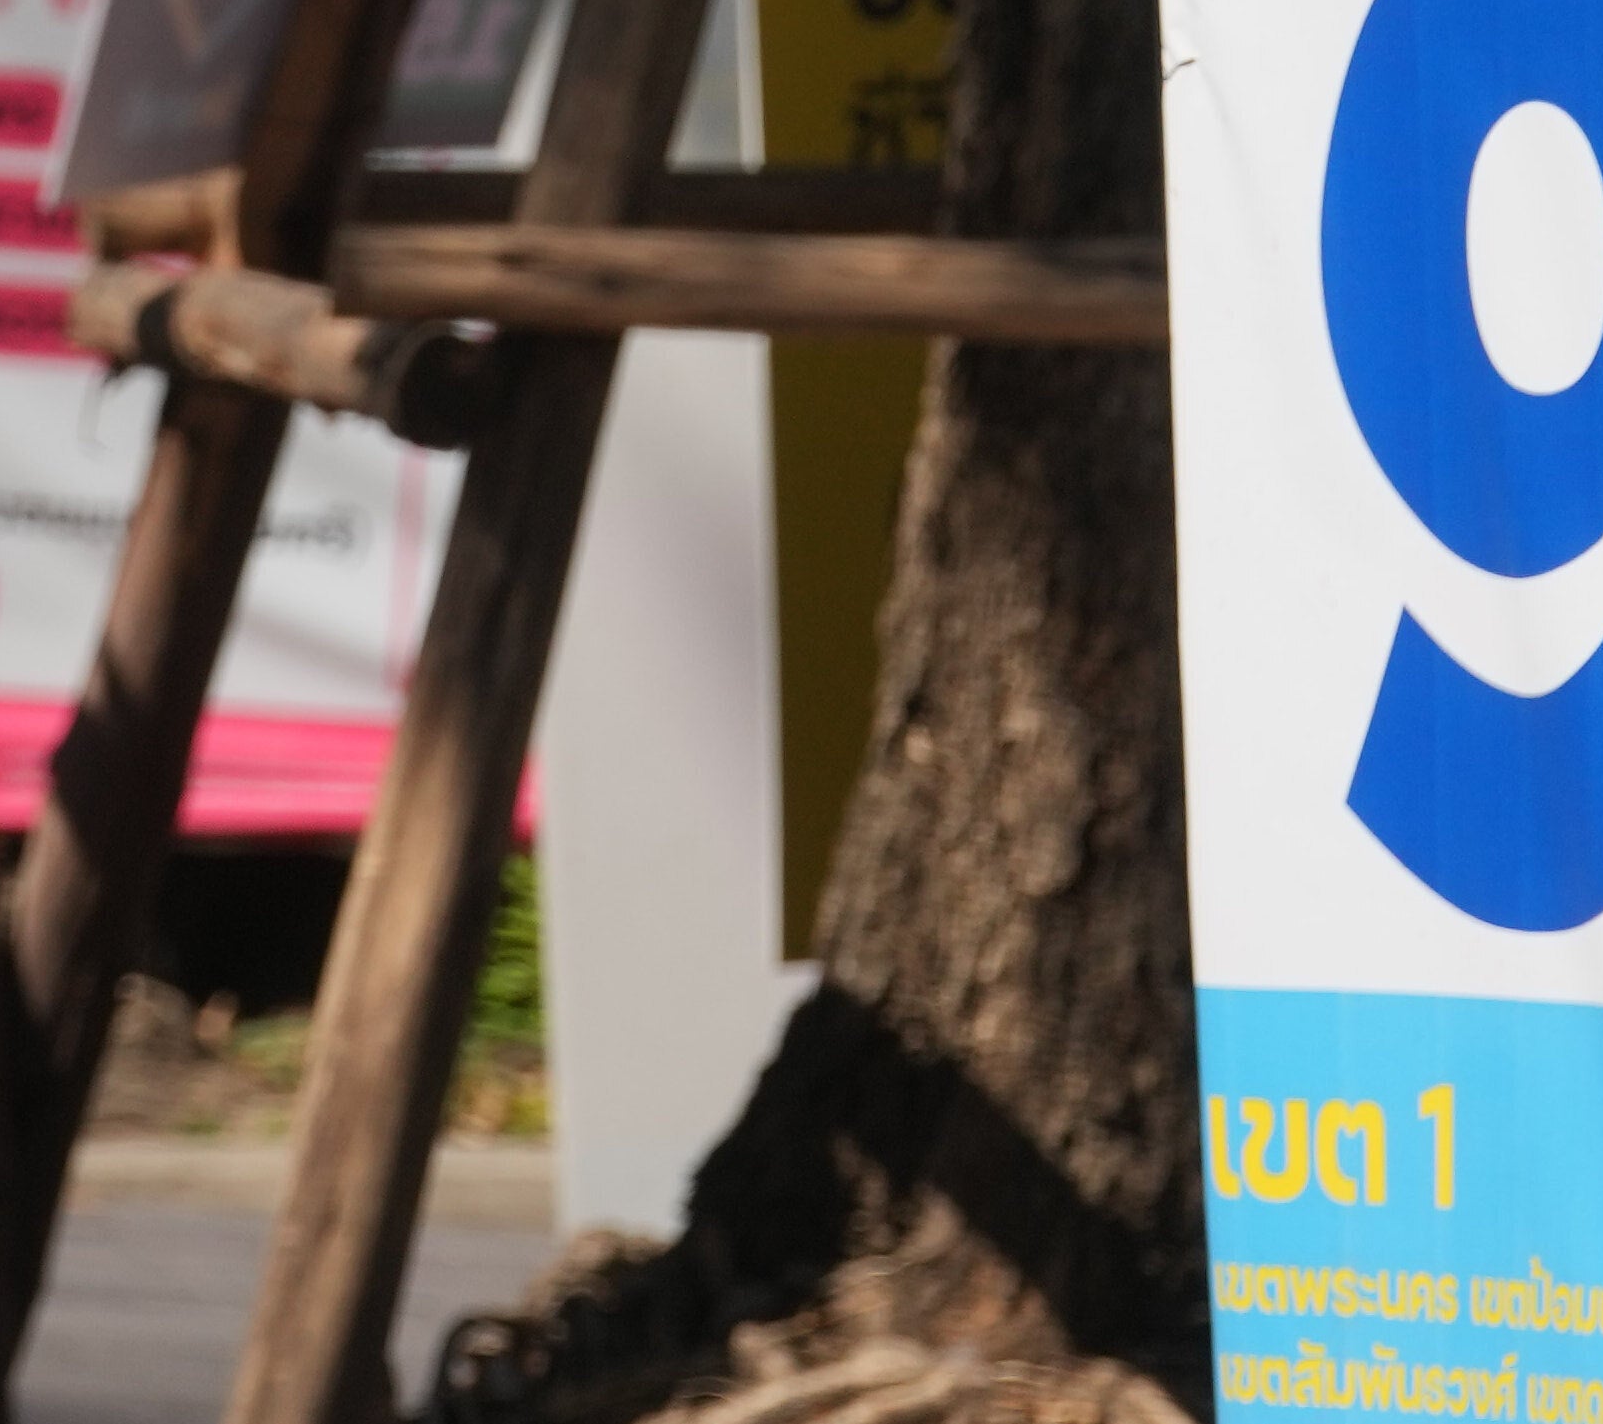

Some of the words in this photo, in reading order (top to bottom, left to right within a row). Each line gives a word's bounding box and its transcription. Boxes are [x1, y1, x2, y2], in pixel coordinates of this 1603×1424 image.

[1207, 1093, 1387, 1207] เขต
[1416, 1082, 1456, 1211] 1
[1213, 1262, 1460, 1325] เขตพระนคร
